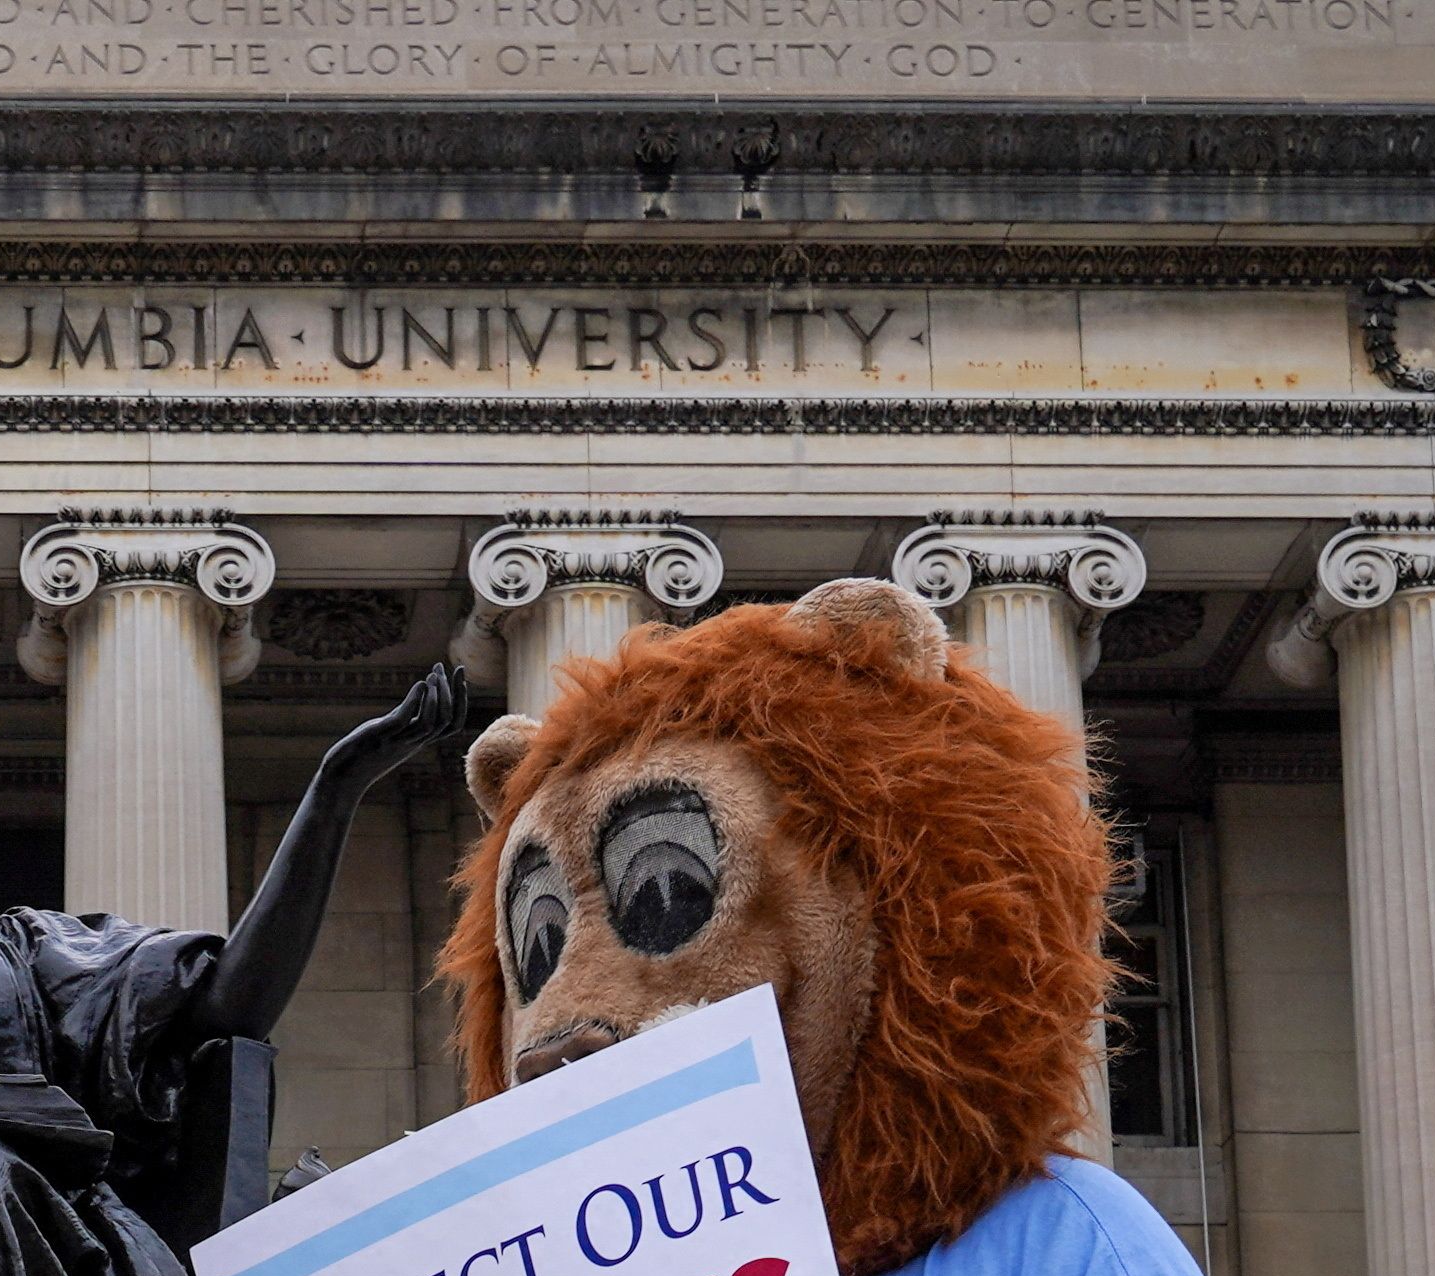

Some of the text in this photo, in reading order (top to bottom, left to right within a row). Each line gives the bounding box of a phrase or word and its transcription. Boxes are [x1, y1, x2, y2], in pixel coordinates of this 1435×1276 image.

[50, 0, 150, 28] AND
[188, 0, 458, 28] CHERISHED
[492, 0, 624, 28] FROM
[656, 0, 964, 28] GENERATION
[996, 0, 1056, 28] TO
[1085, 0, 1397, 28] GENERATION
[44, 44, 147, 78] AND
[177, 44, 272, 78] THE
[304, 44, 464, 78] GLORY
[495, 44, 556, 78] OF
[589, 44, 851, 78] ALMIGHTY
[885, 44, 998, 78] GOD
[329, 305, 898, 373] UNIVERSITY
[575, 1145, 780, 1269] OUR
